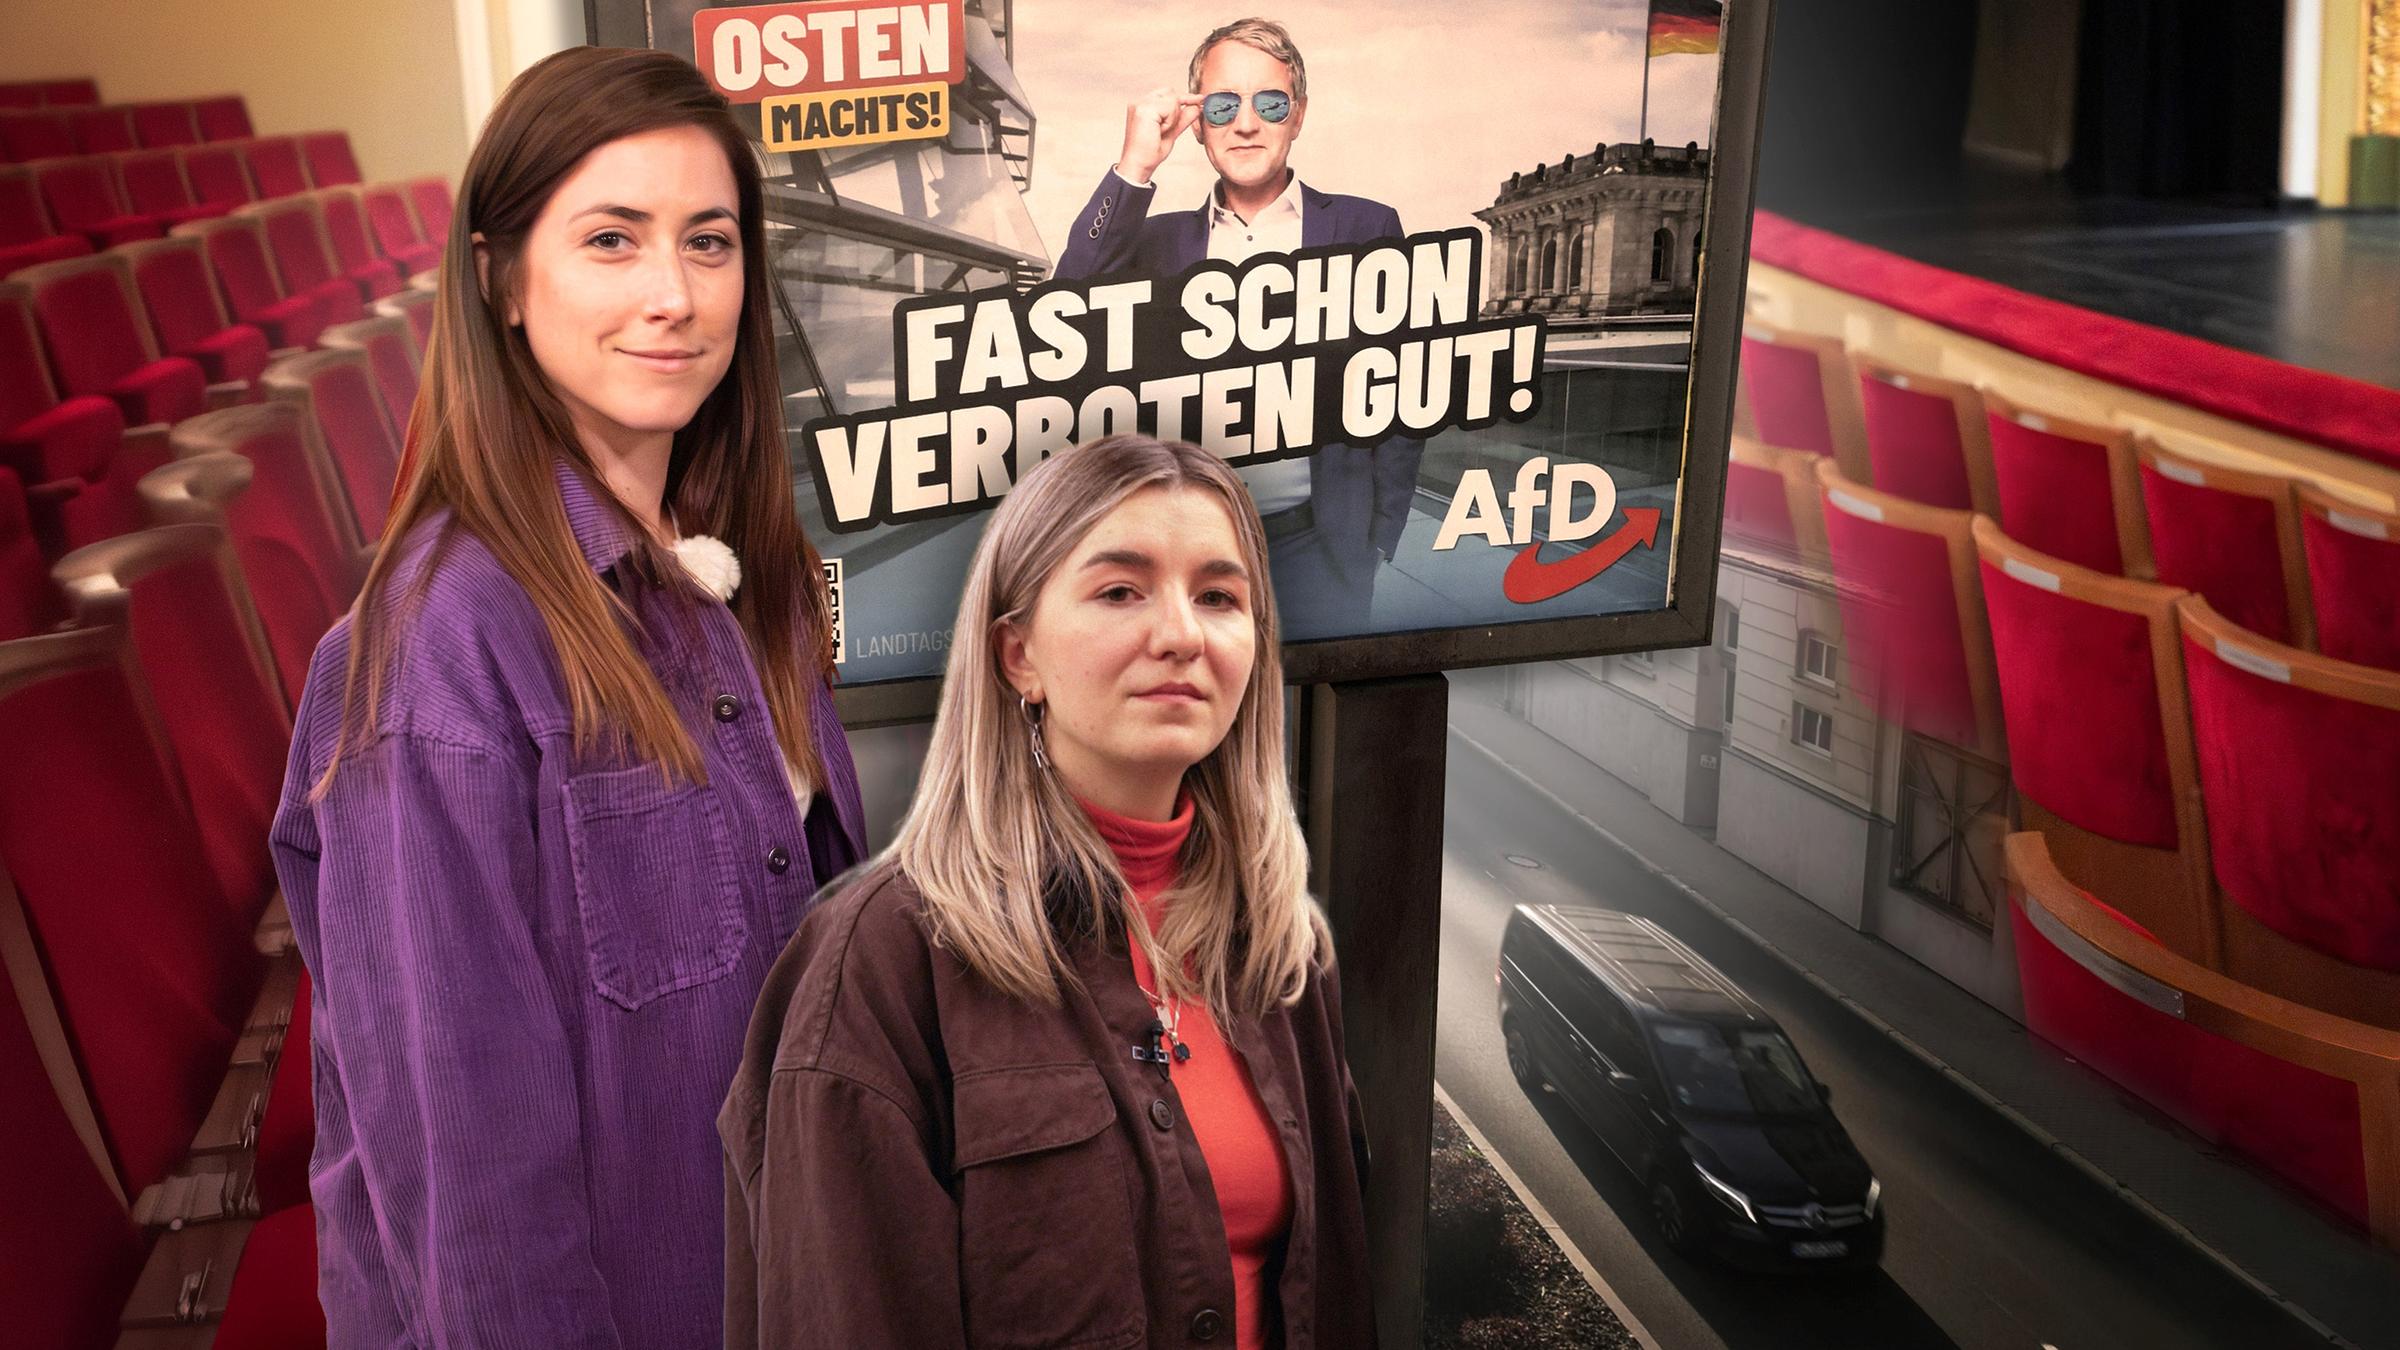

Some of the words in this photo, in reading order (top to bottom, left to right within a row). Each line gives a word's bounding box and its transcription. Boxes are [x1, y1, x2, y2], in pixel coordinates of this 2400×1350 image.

[713, 3, 950, 91] OSTEN
[771, 91, 942, 143] MACHTS!
[906, 280, 1153, 402] FAST
[1180, 237, 1475, 361] SCHON
[1341, 324, 1539, 438] GUT!
[1432, 456, 1617, 550] AfD
